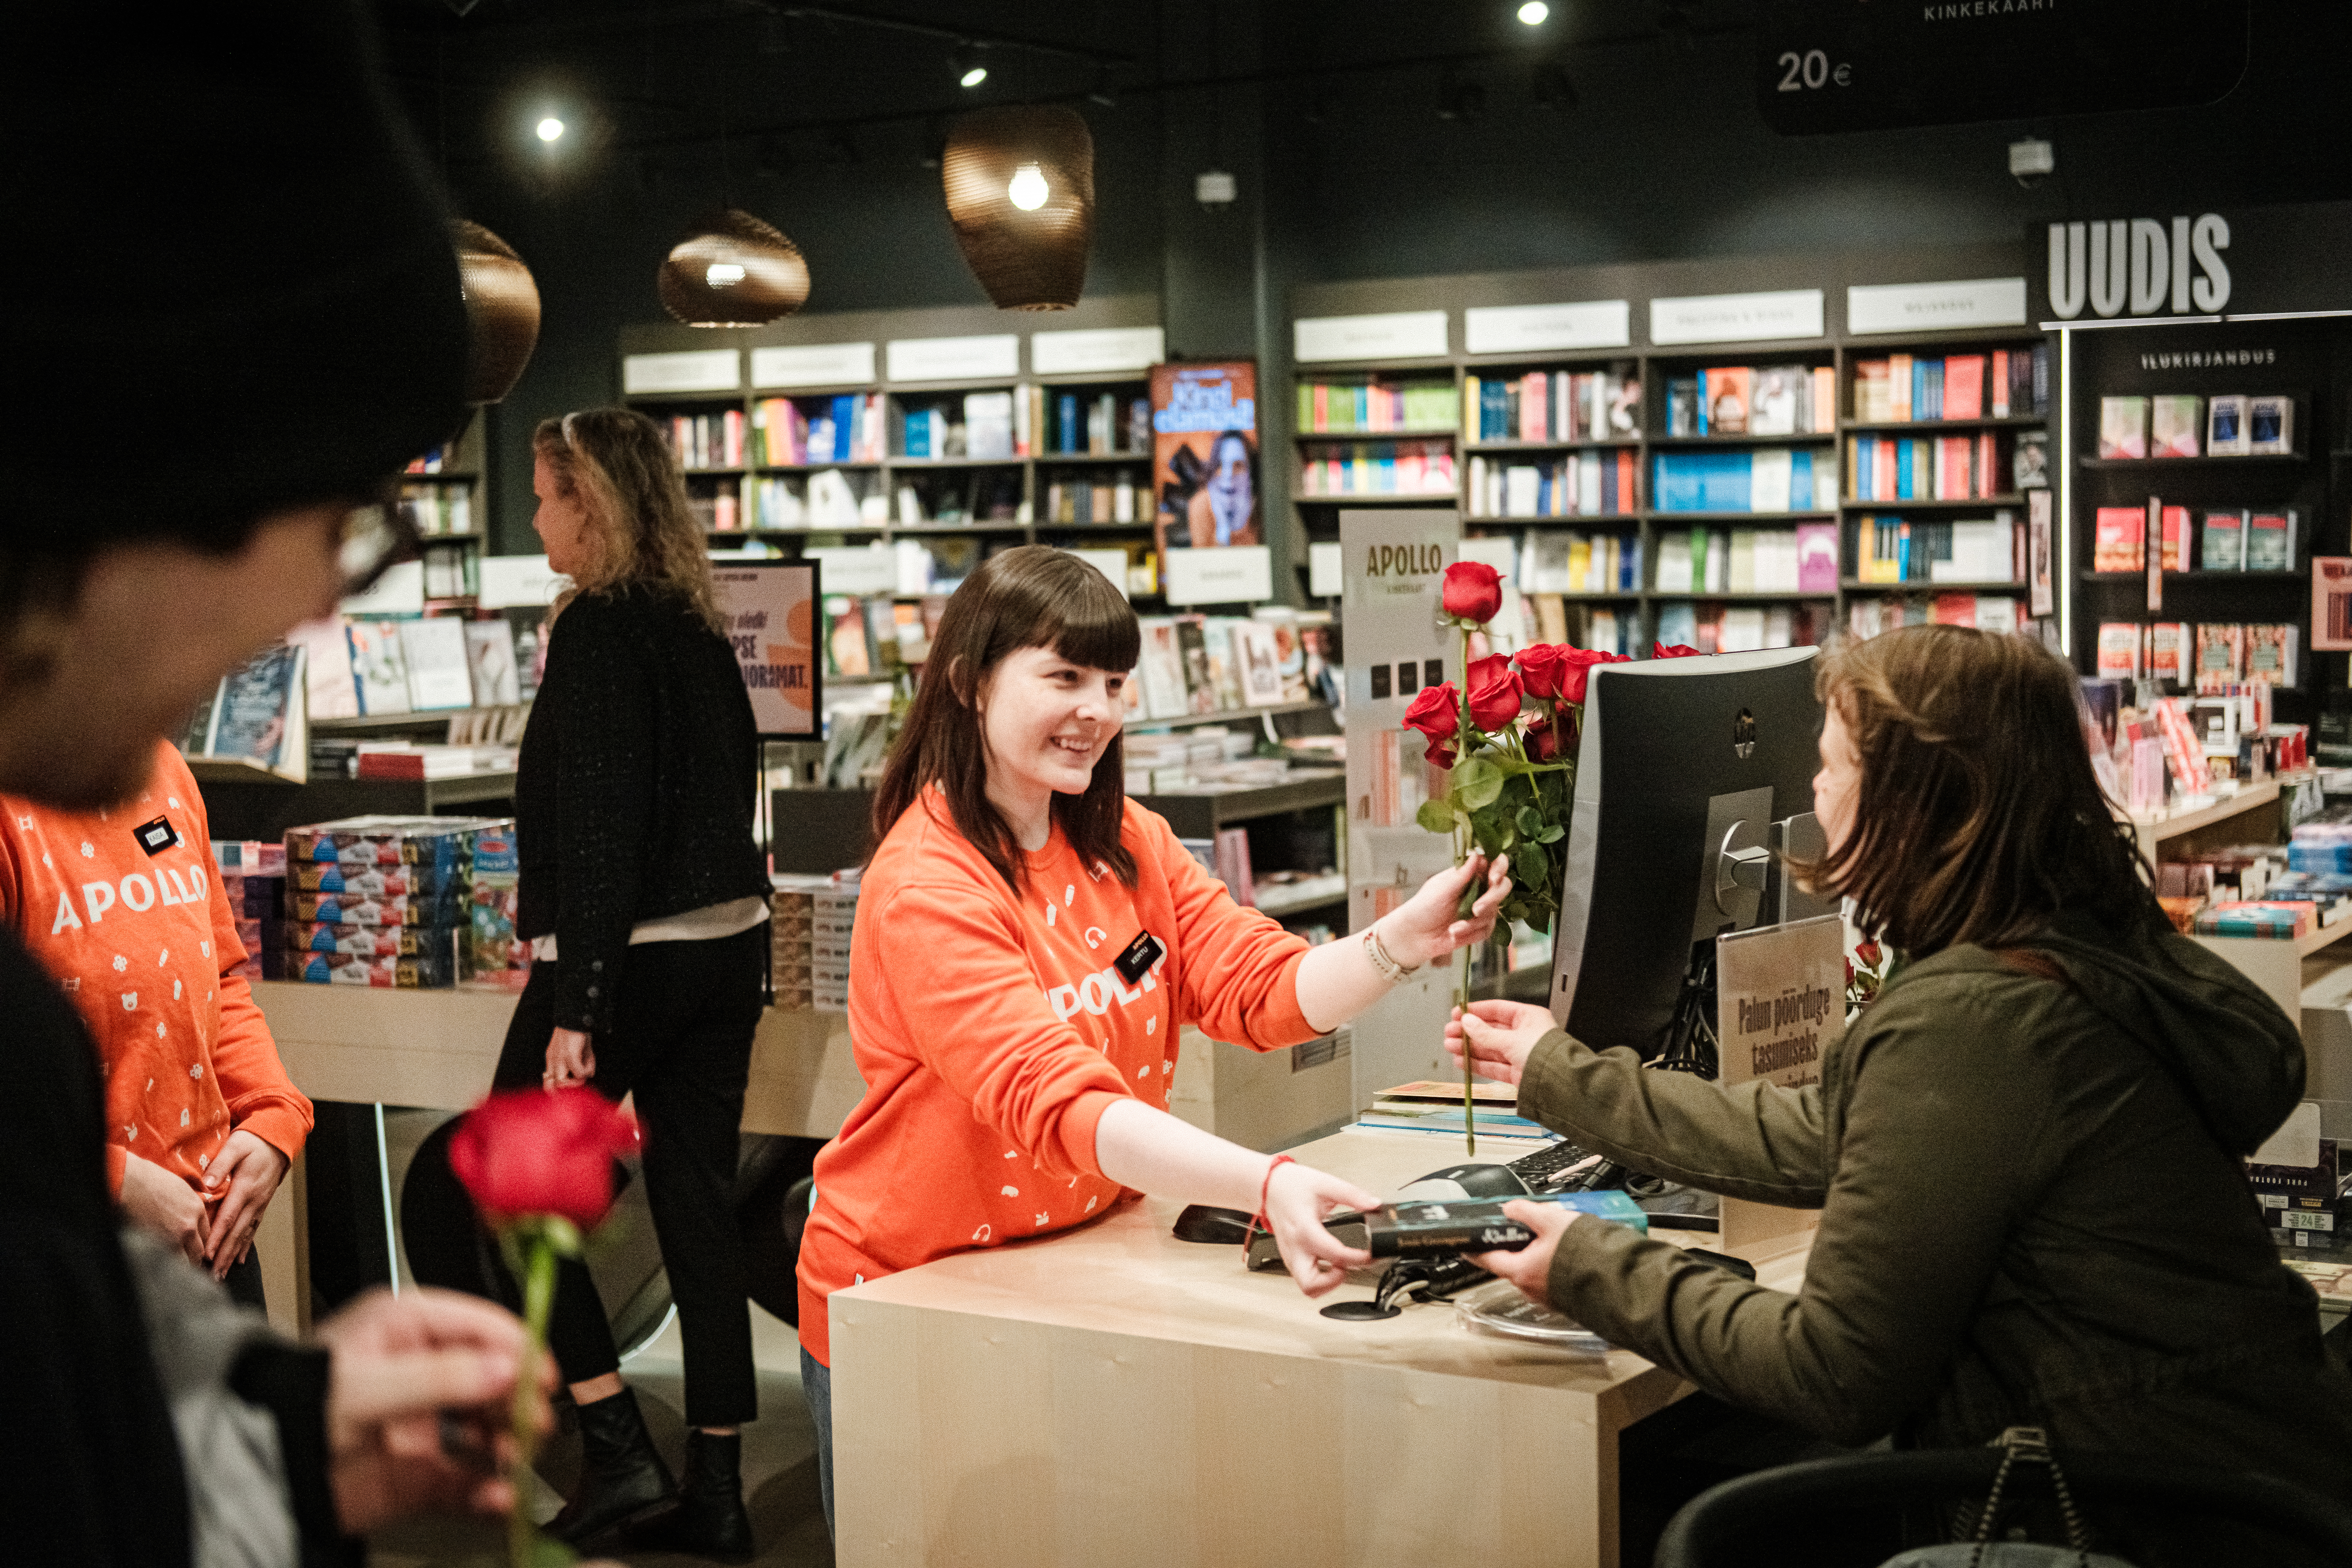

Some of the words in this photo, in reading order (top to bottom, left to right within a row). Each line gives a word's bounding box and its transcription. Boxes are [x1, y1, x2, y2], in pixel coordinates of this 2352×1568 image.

[2049, 213, 2231, 319] UUDIS
[2141, 348, 2275, 370] ILUKIRJANDUS
[1366, 544, 1442, 577] APOLLO
[732, 635, 756, 659] PSE
[51, 865, 207, 935] APOLLO
[1739, 996, 1771, 1035] Palun
[1775, 984, 1830, 1036] pöörduge
[2250, 1176, 2281, 1184] FOOTBA
[2301, 1215, 2313, 1226] 24
